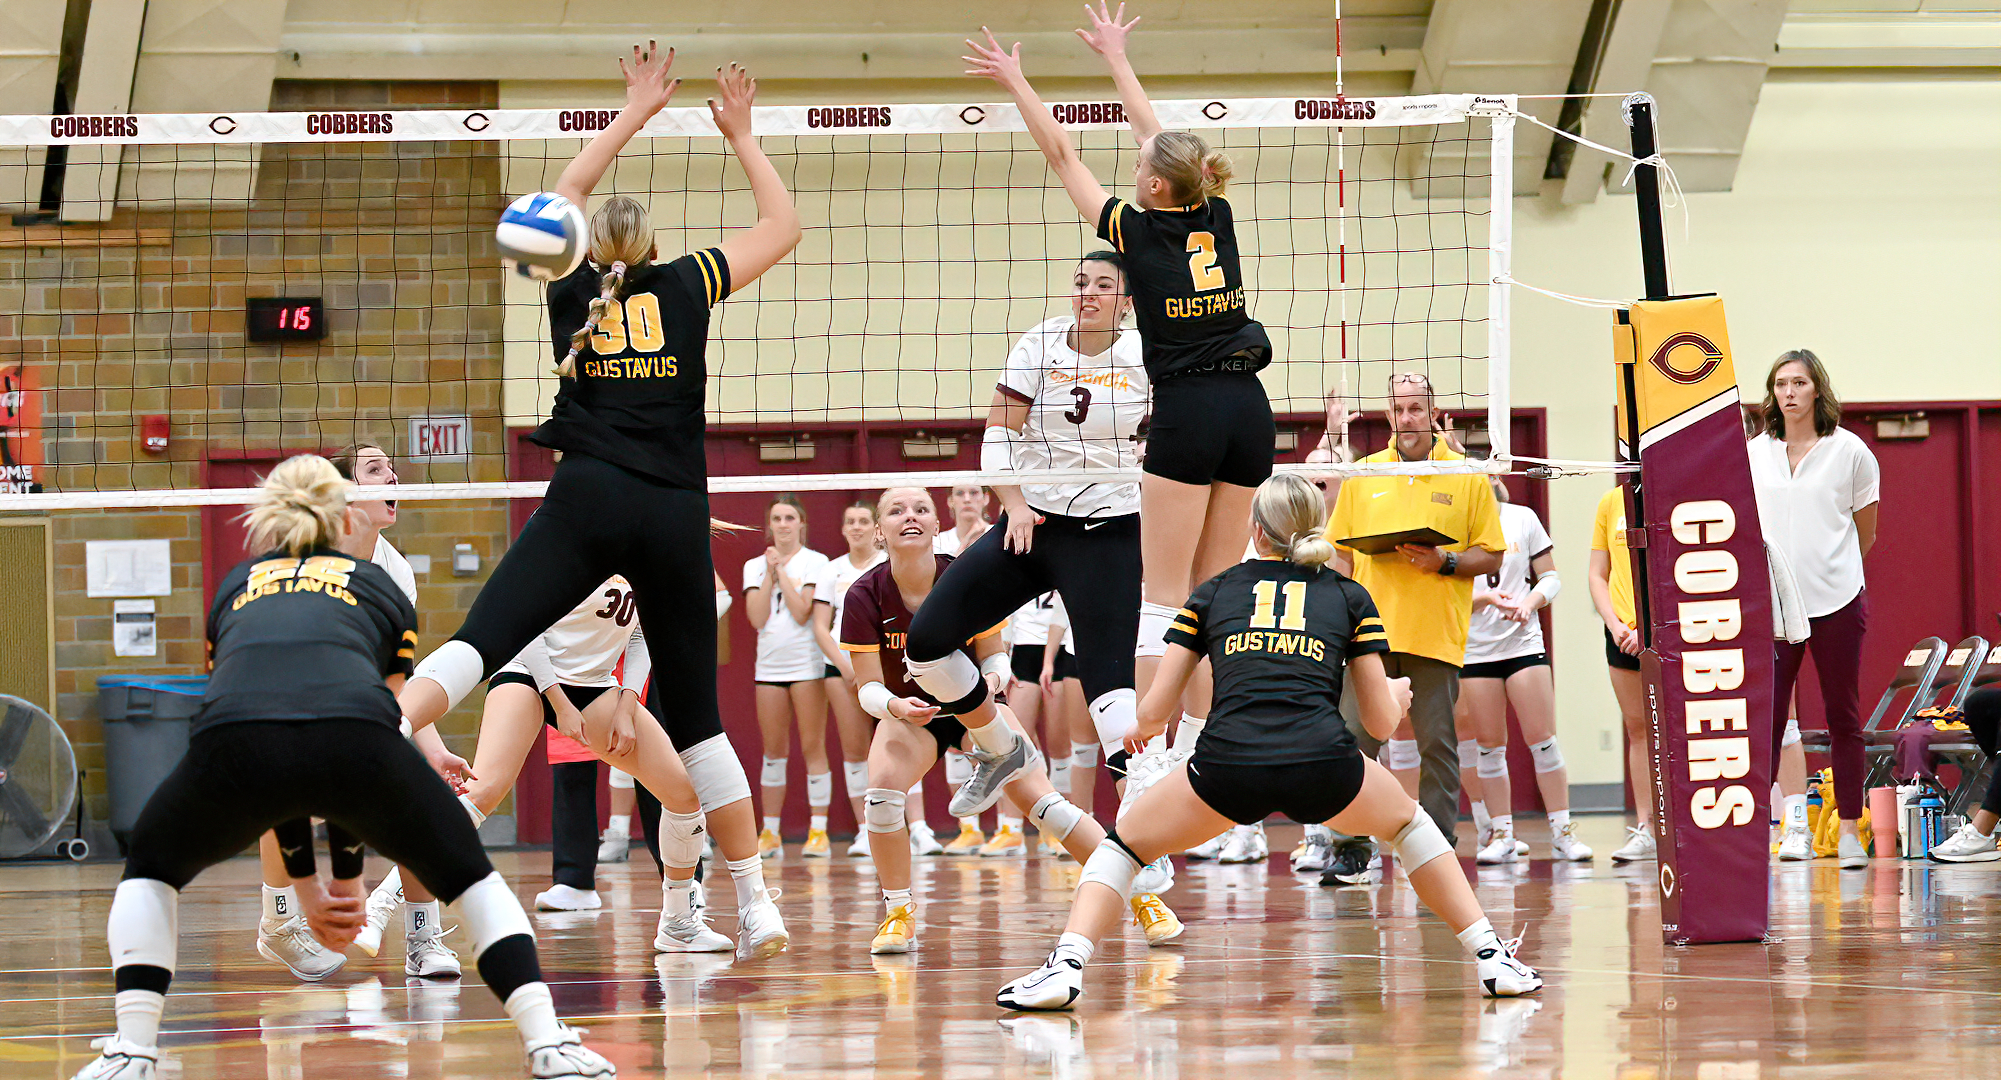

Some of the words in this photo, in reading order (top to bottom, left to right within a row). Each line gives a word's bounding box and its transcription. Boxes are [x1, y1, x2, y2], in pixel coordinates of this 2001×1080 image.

[306, 113, 393, 135] COBBERS
[559, 110, 644, 132] COBB
[807, 106, 891, 128] COBBERS
[1052, 103, 1129, 125] COBBER
[1294, 99, 1377, 120] COBBERS
[51, 116, 138, 138] COBBERS
[1186, 231, 1226, 292] 2
[1165, 286, 1244, 318] GUSTAVUS
[589, 292, 665, 355] 30
[585, 356, 678, 378] GUSTAVUS
[1064, 387, 1092, 425] 3
[419, 424, 462, 454] EXIT
[232, 578, 359, 611] GUSTAVUS
[596, 588, 636, 628] 30
[1249, 580, 1307, 631] 11
[1225, 632, 1326, 663] GUSTAVUS
[1670, 499, 1755, 829] COBBERS
[1648, 684, 1661, 750] sports
[1653, 754, 1667, 837] imports
